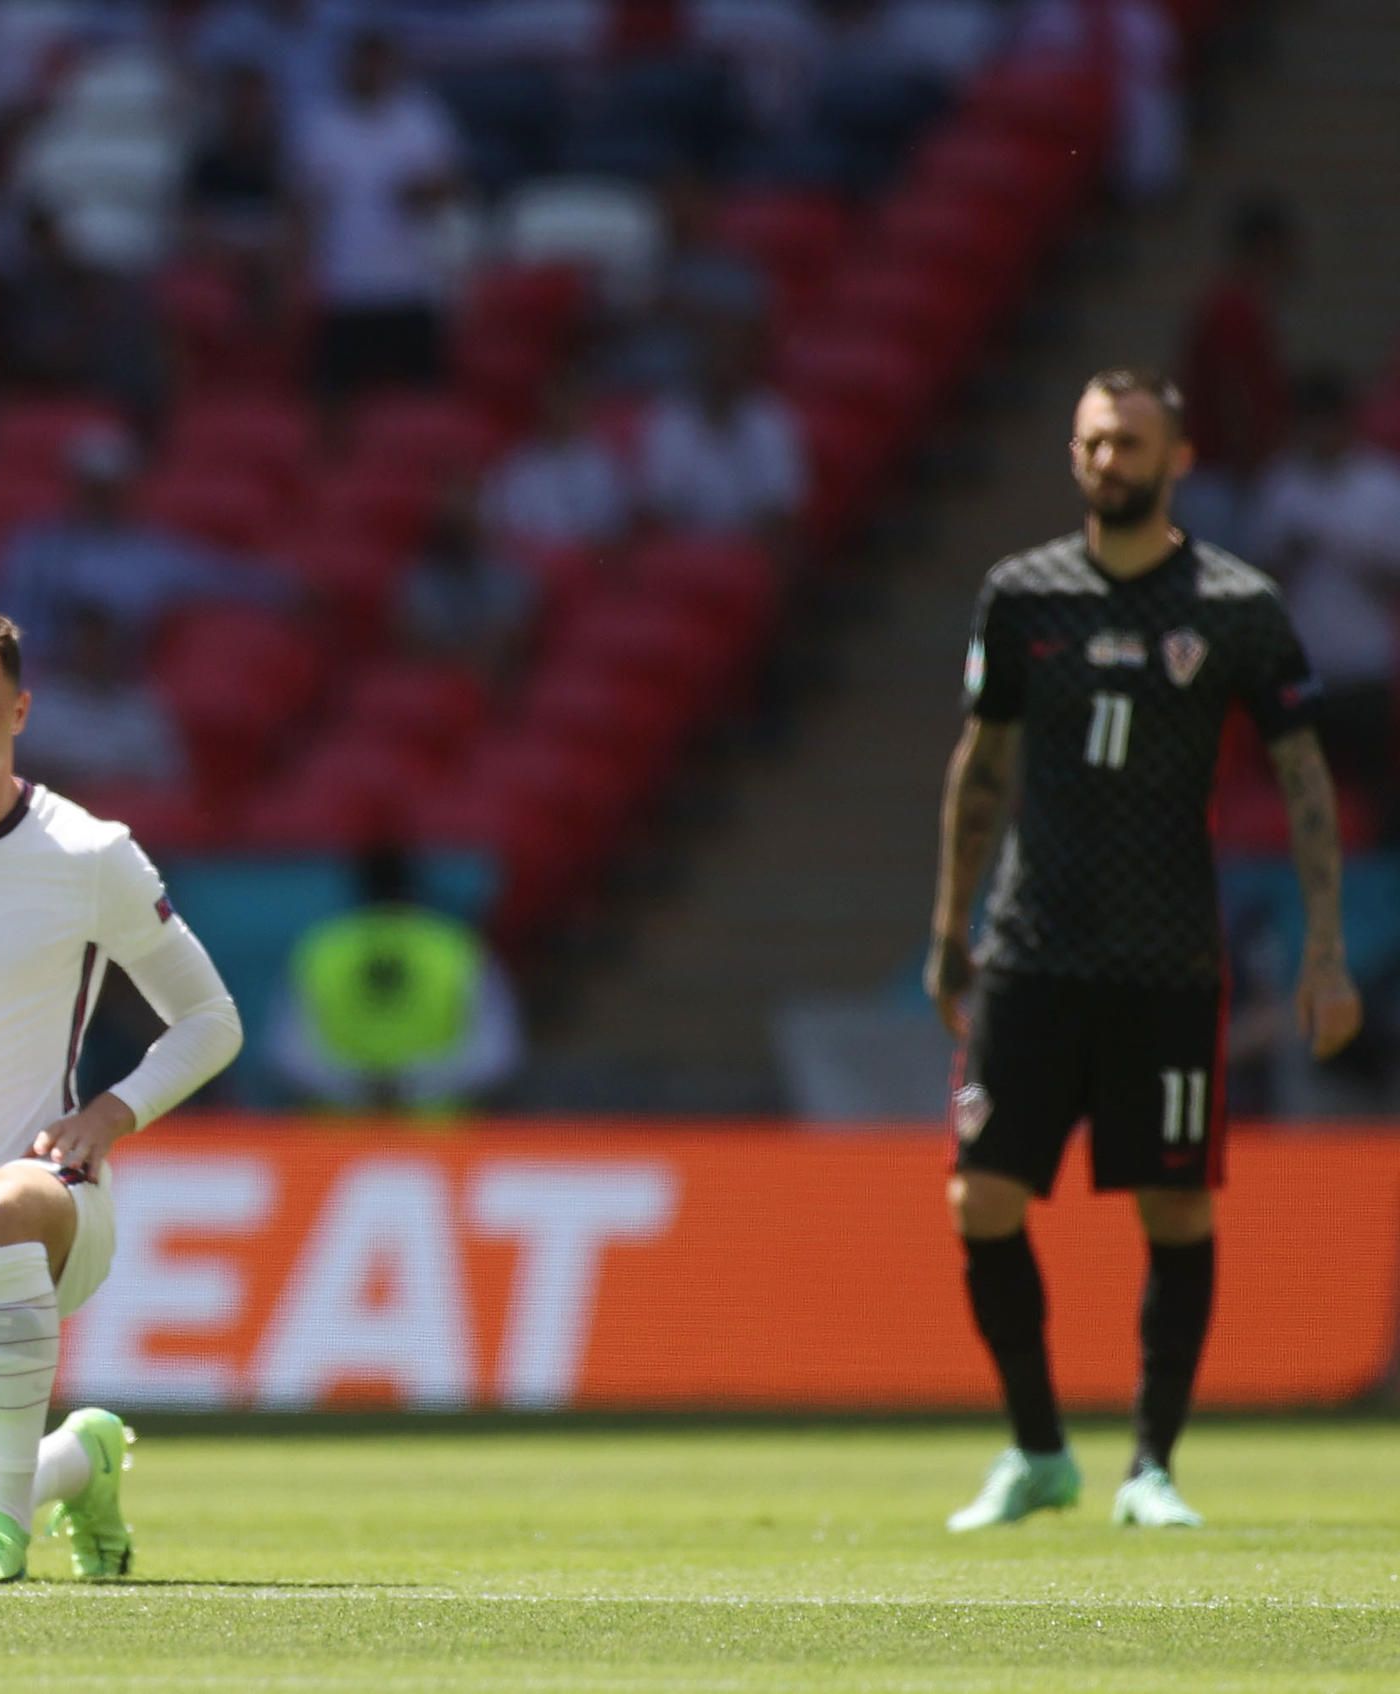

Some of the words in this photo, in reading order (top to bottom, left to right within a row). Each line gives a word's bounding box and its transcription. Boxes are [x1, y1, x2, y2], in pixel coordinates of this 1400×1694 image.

[1084, 694, 1133, 768] 11
[1161, 1068, 1206, 1142] 11
[60, 1147, 676, 1412] EAT
